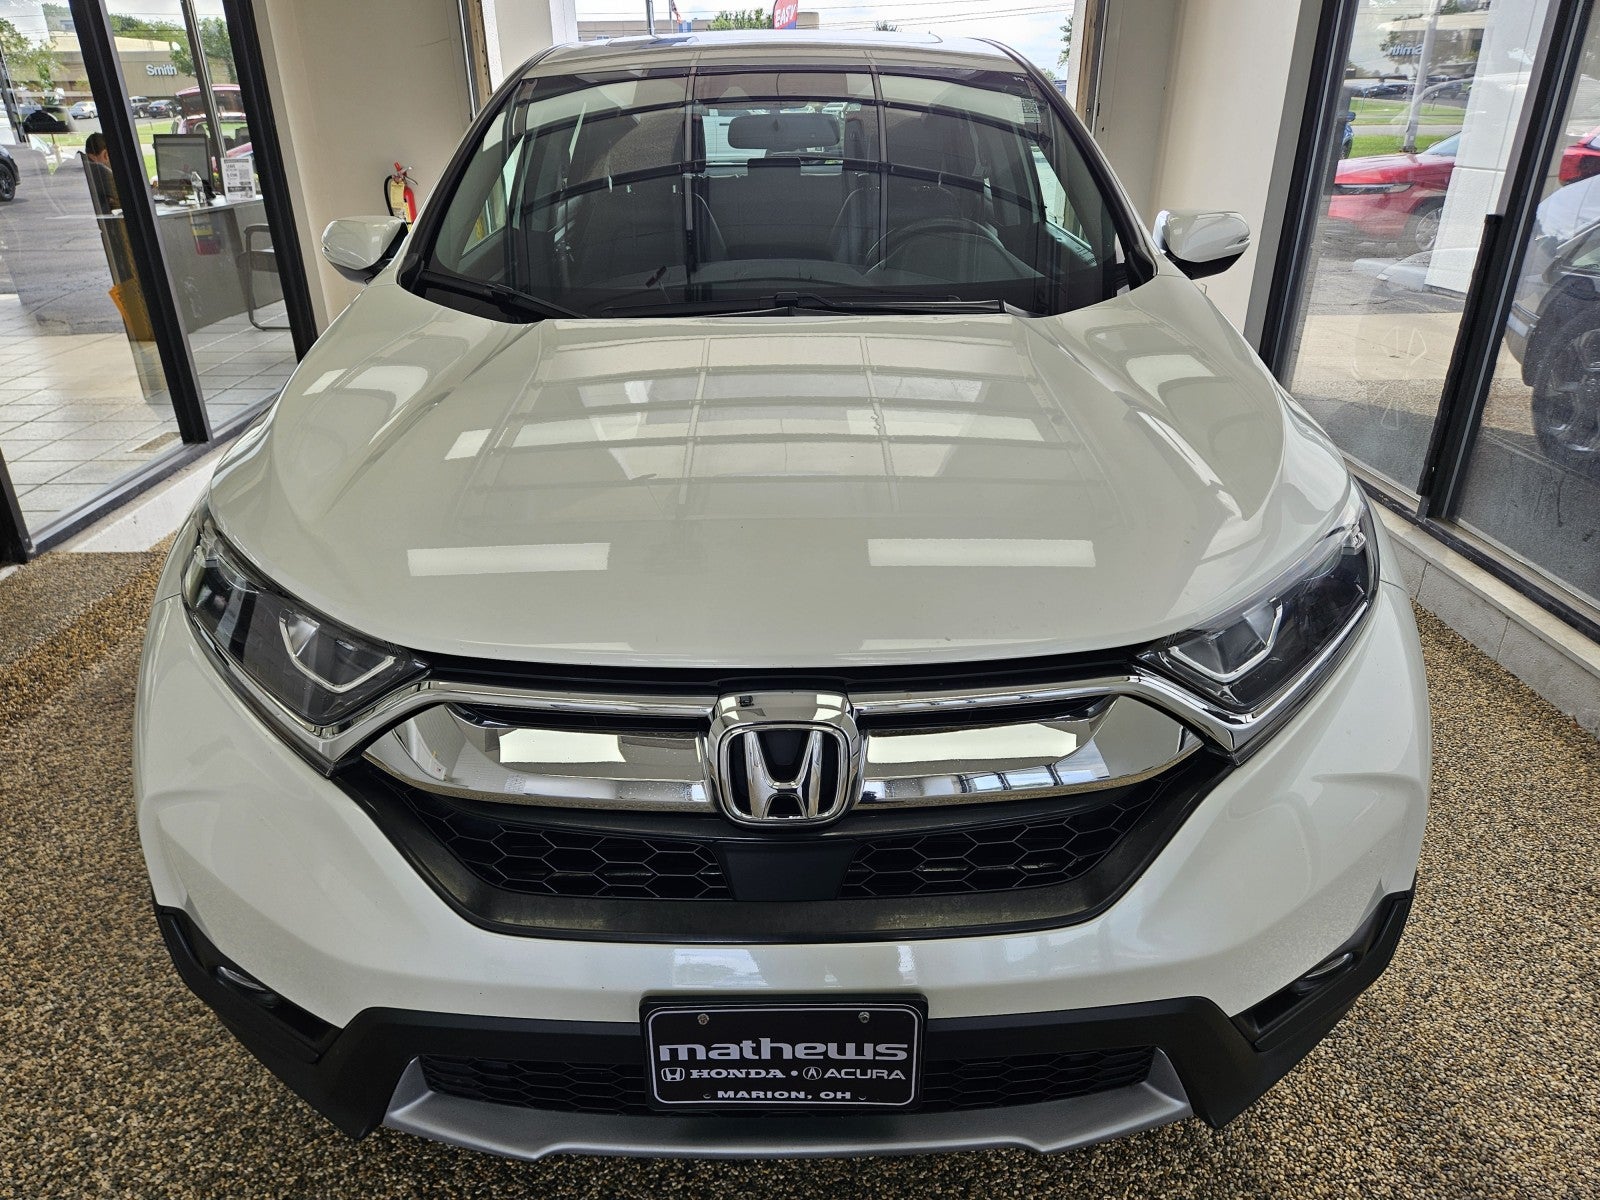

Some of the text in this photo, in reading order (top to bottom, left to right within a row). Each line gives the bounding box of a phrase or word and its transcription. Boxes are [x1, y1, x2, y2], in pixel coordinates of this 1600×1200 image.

[774, 3, 797, 28] EASY
[145, 64, 178, 76] Smith
[659, 1037, 908, 1061] mathews
[689, 1068, 786, 1079] HONDA
[824, 1068, 907, 1080] ACURA
[717, 1090, 851, 1100] MARION, OH
